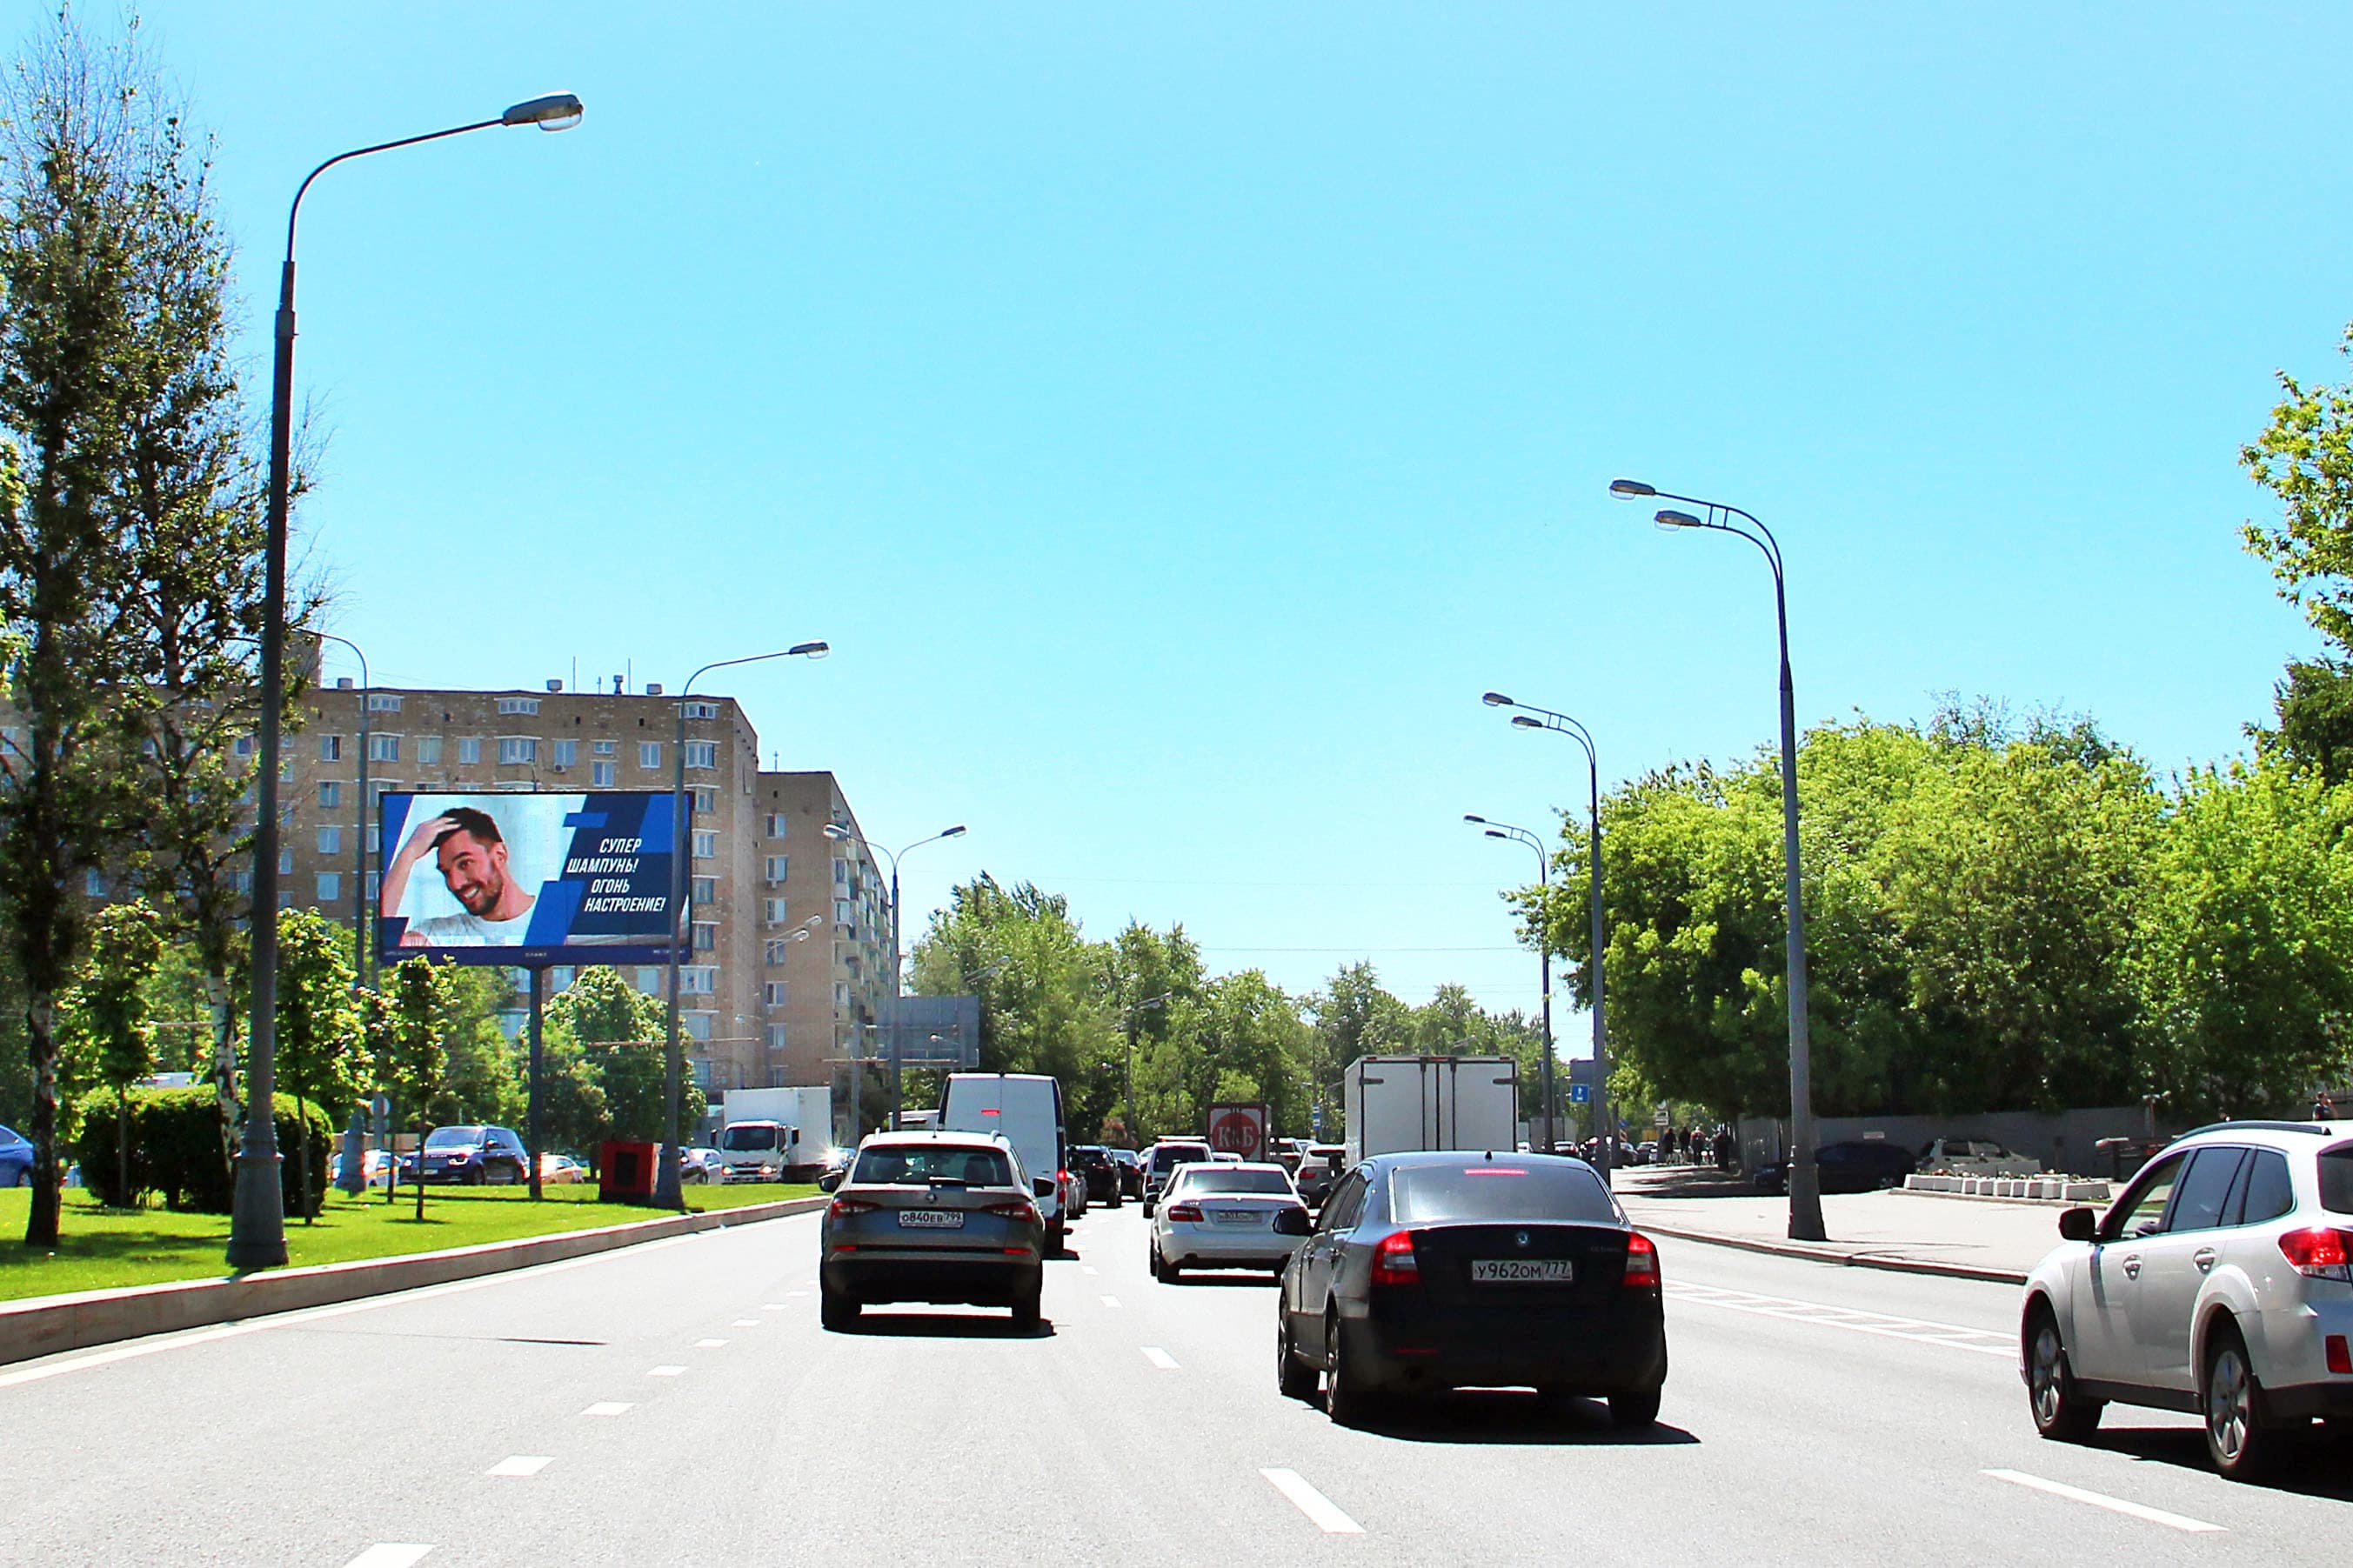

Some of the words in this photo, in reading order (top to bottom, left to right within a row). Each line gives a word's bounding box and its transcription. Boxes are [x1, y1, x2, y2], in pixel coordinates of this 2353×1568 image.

[599, 838, 642, 853] СУПЕР
[566, 857, 639, 873] ШАМПУНЬ!
[591, 878, 630, 893] ОГОНЬ
[584, 897, 666, 912] НАСТРОЕНИЕ!
